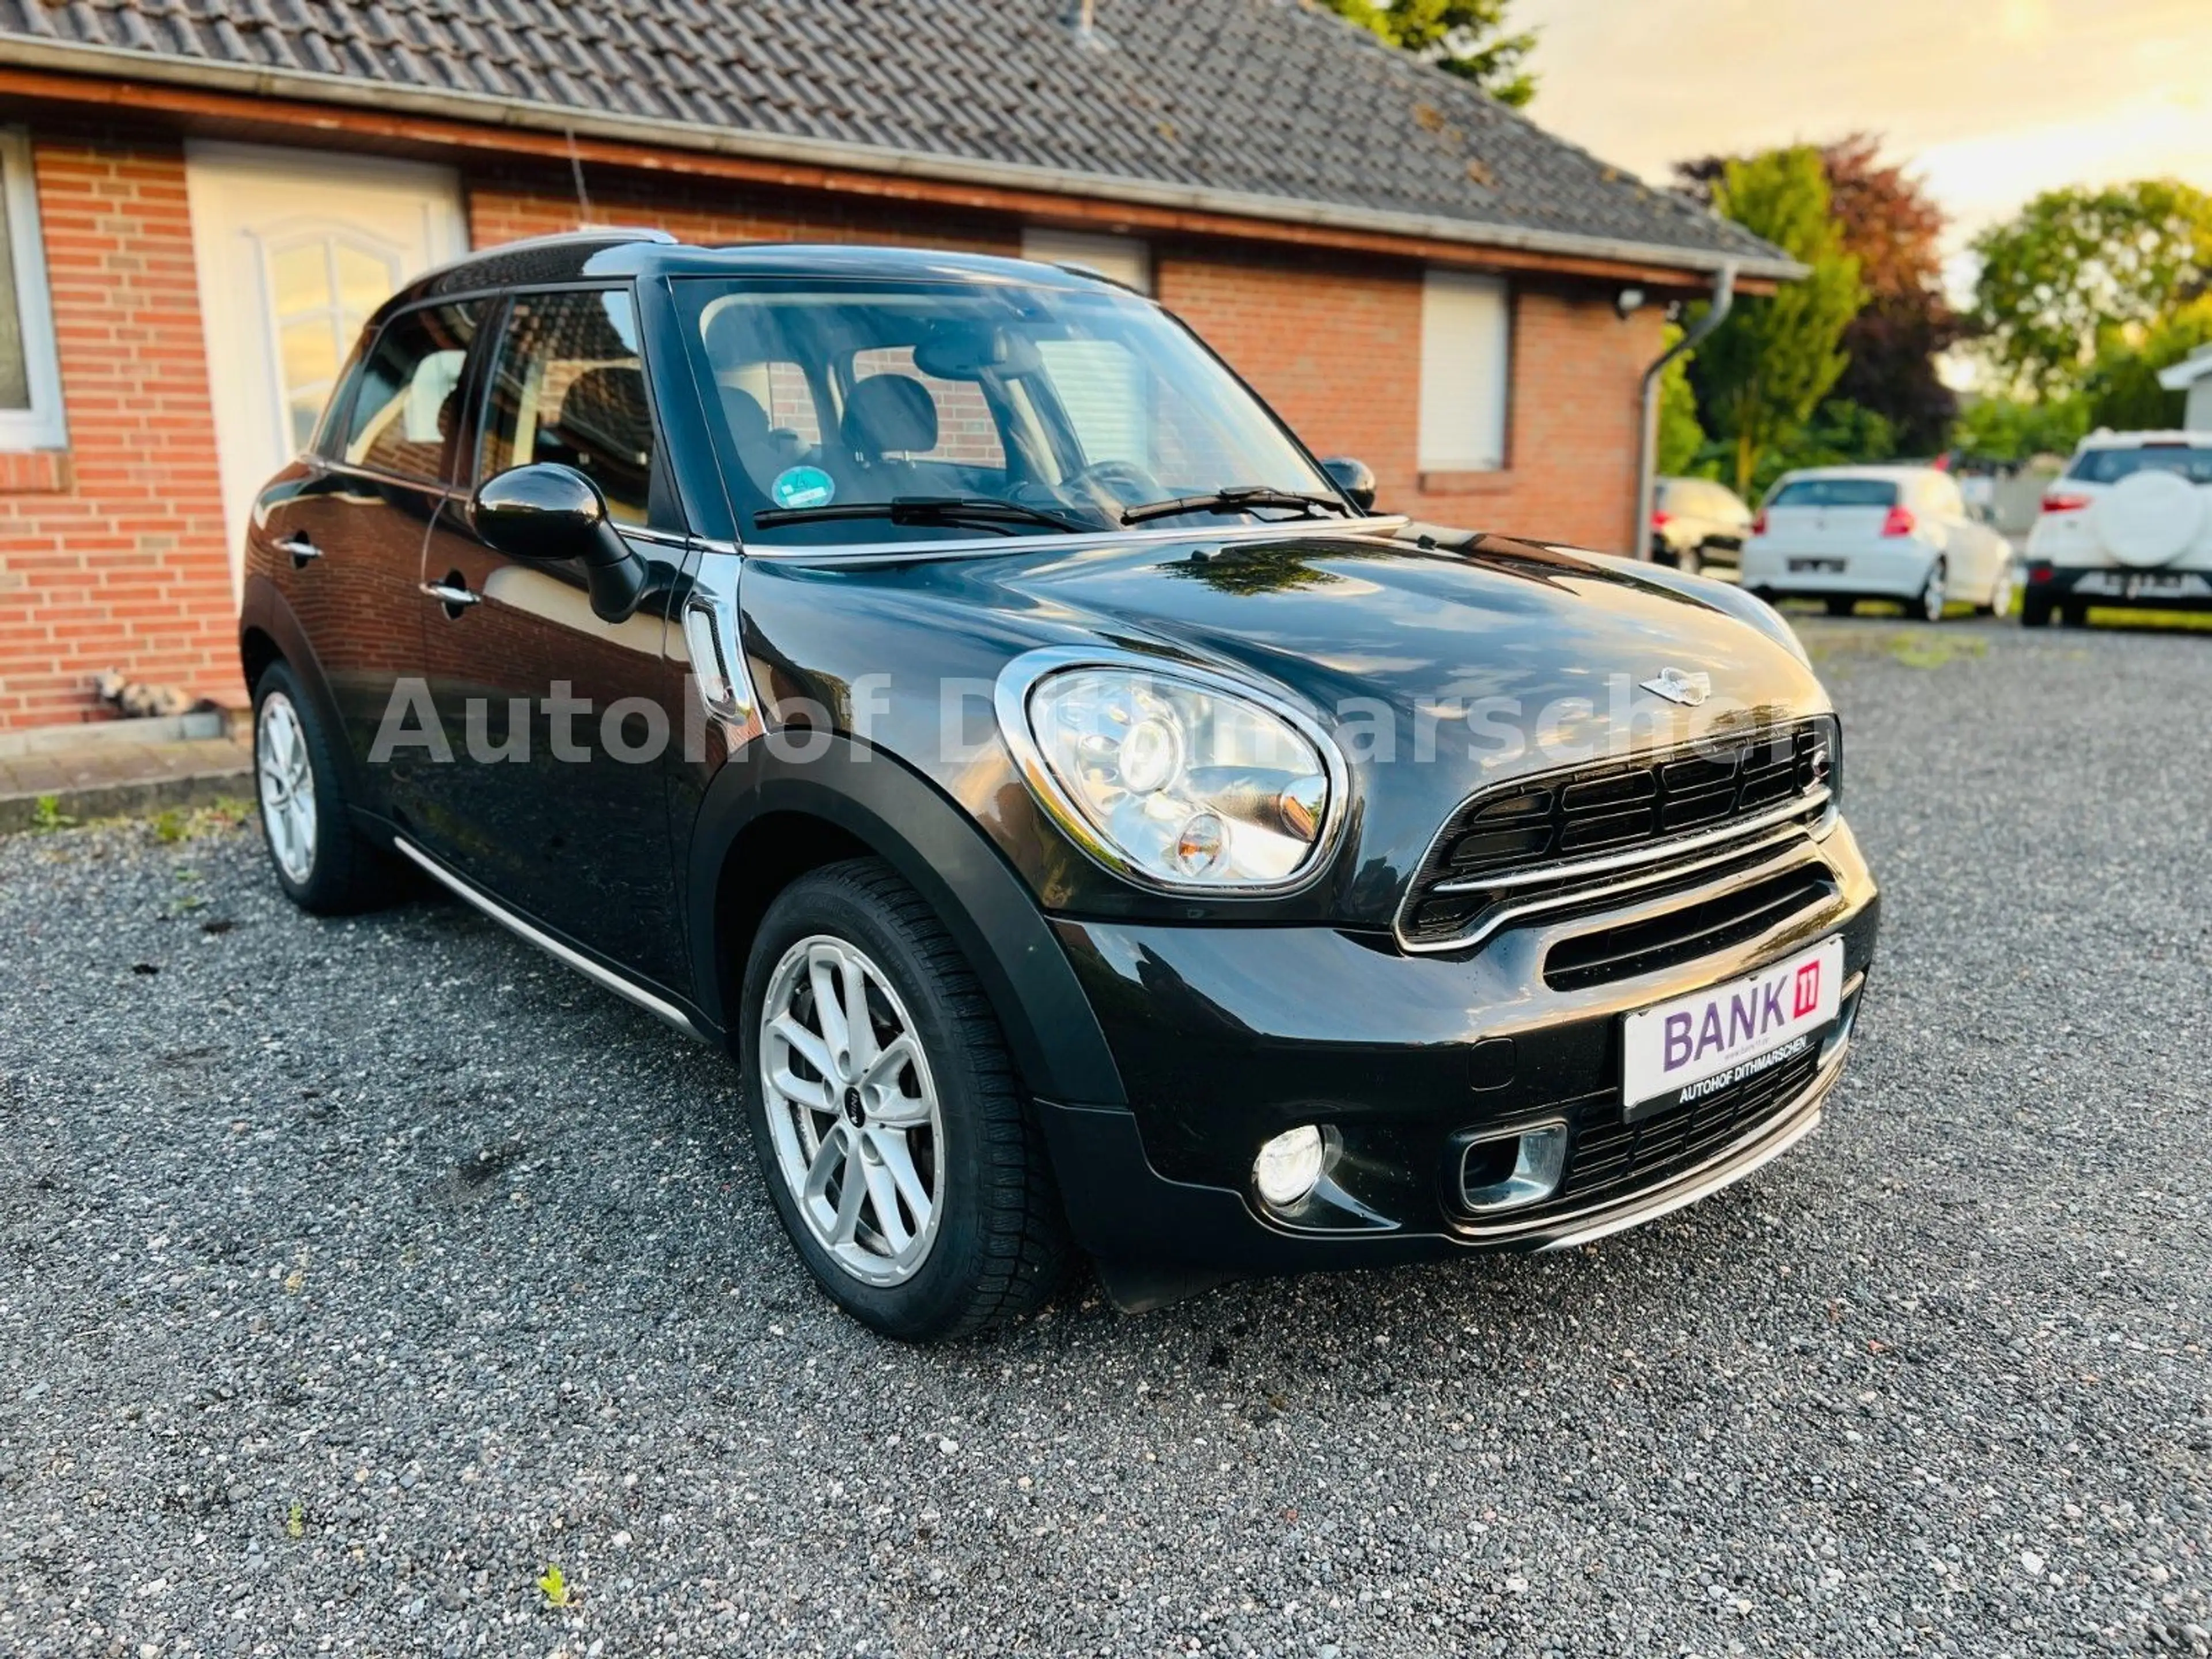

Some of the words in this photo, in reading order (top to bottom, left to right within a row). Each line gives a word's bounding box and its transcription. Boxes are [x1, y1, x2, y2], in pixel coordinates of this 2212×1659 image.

[1663, 975, 1787, 1073] BANK
[1679, 1070, 1733, 1104] AUTOHOF
[1734, 1035, 1807, 1082] DITHMARSCHEN
